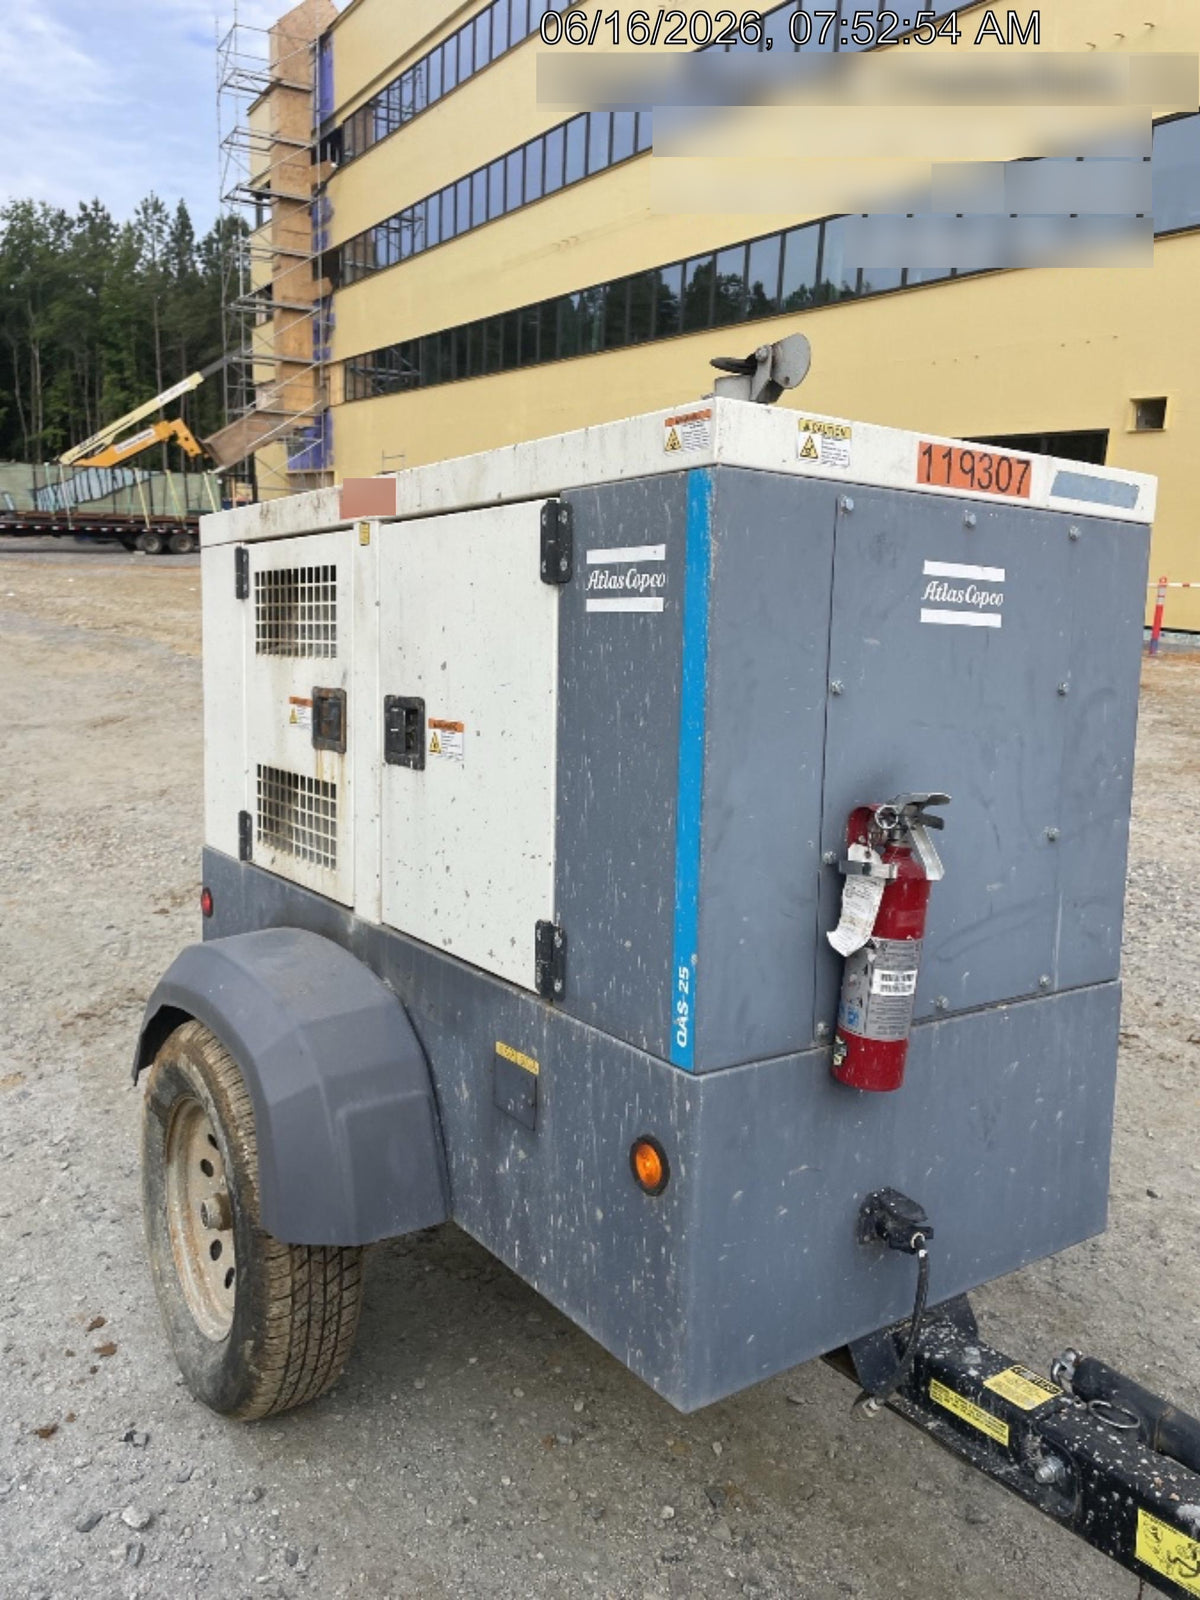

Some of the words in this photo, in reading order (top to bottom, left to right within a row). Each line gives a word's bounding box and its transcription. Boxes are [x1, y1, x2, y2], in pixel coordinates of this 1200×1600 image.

[922, 443, 1031, 495] 119307
[678, 966, 690, 994] 25
[676, 999, 689, 1048] QAS
